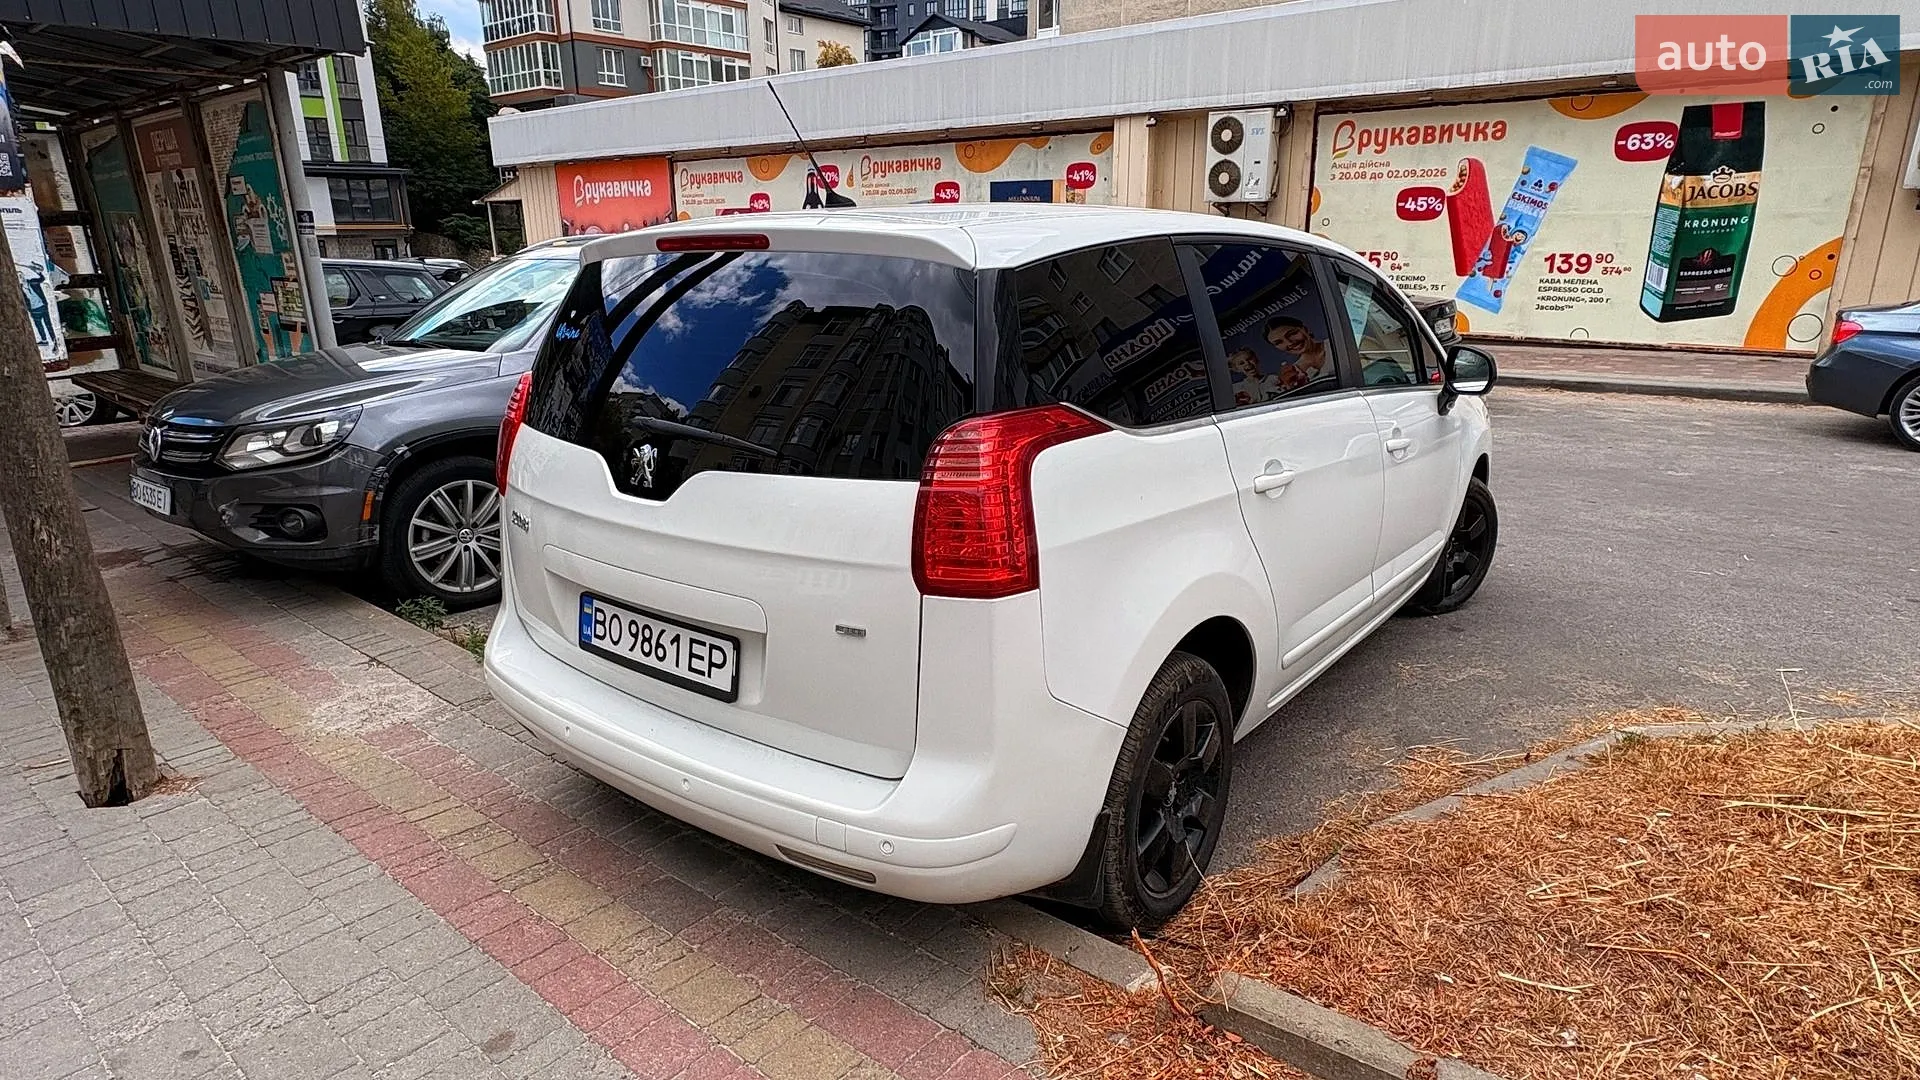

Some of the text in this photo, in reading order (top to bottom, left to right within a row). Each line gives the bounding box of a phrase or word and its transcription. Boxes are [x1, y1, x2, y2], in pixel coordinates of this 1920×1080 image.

[1617, 132, 1675, 151] -63%
[1068, 169, 1095, 181] -41%
[1338, 171, 1366, 181] 20.08
[1370, 171, 1384, 180] до
[936, 188, 959, 199] -43%
[1685, 181, 1759, 202] JACOBS
[750, 199, 770, 210] -42%
[1398, 196, 1444, 212] -45%
[1511, 191, 1549, 210] ESKIMOS
[1544, 253, 1615, 274] 139 90
[593, 606, 727, 679] BO 9861 EP
